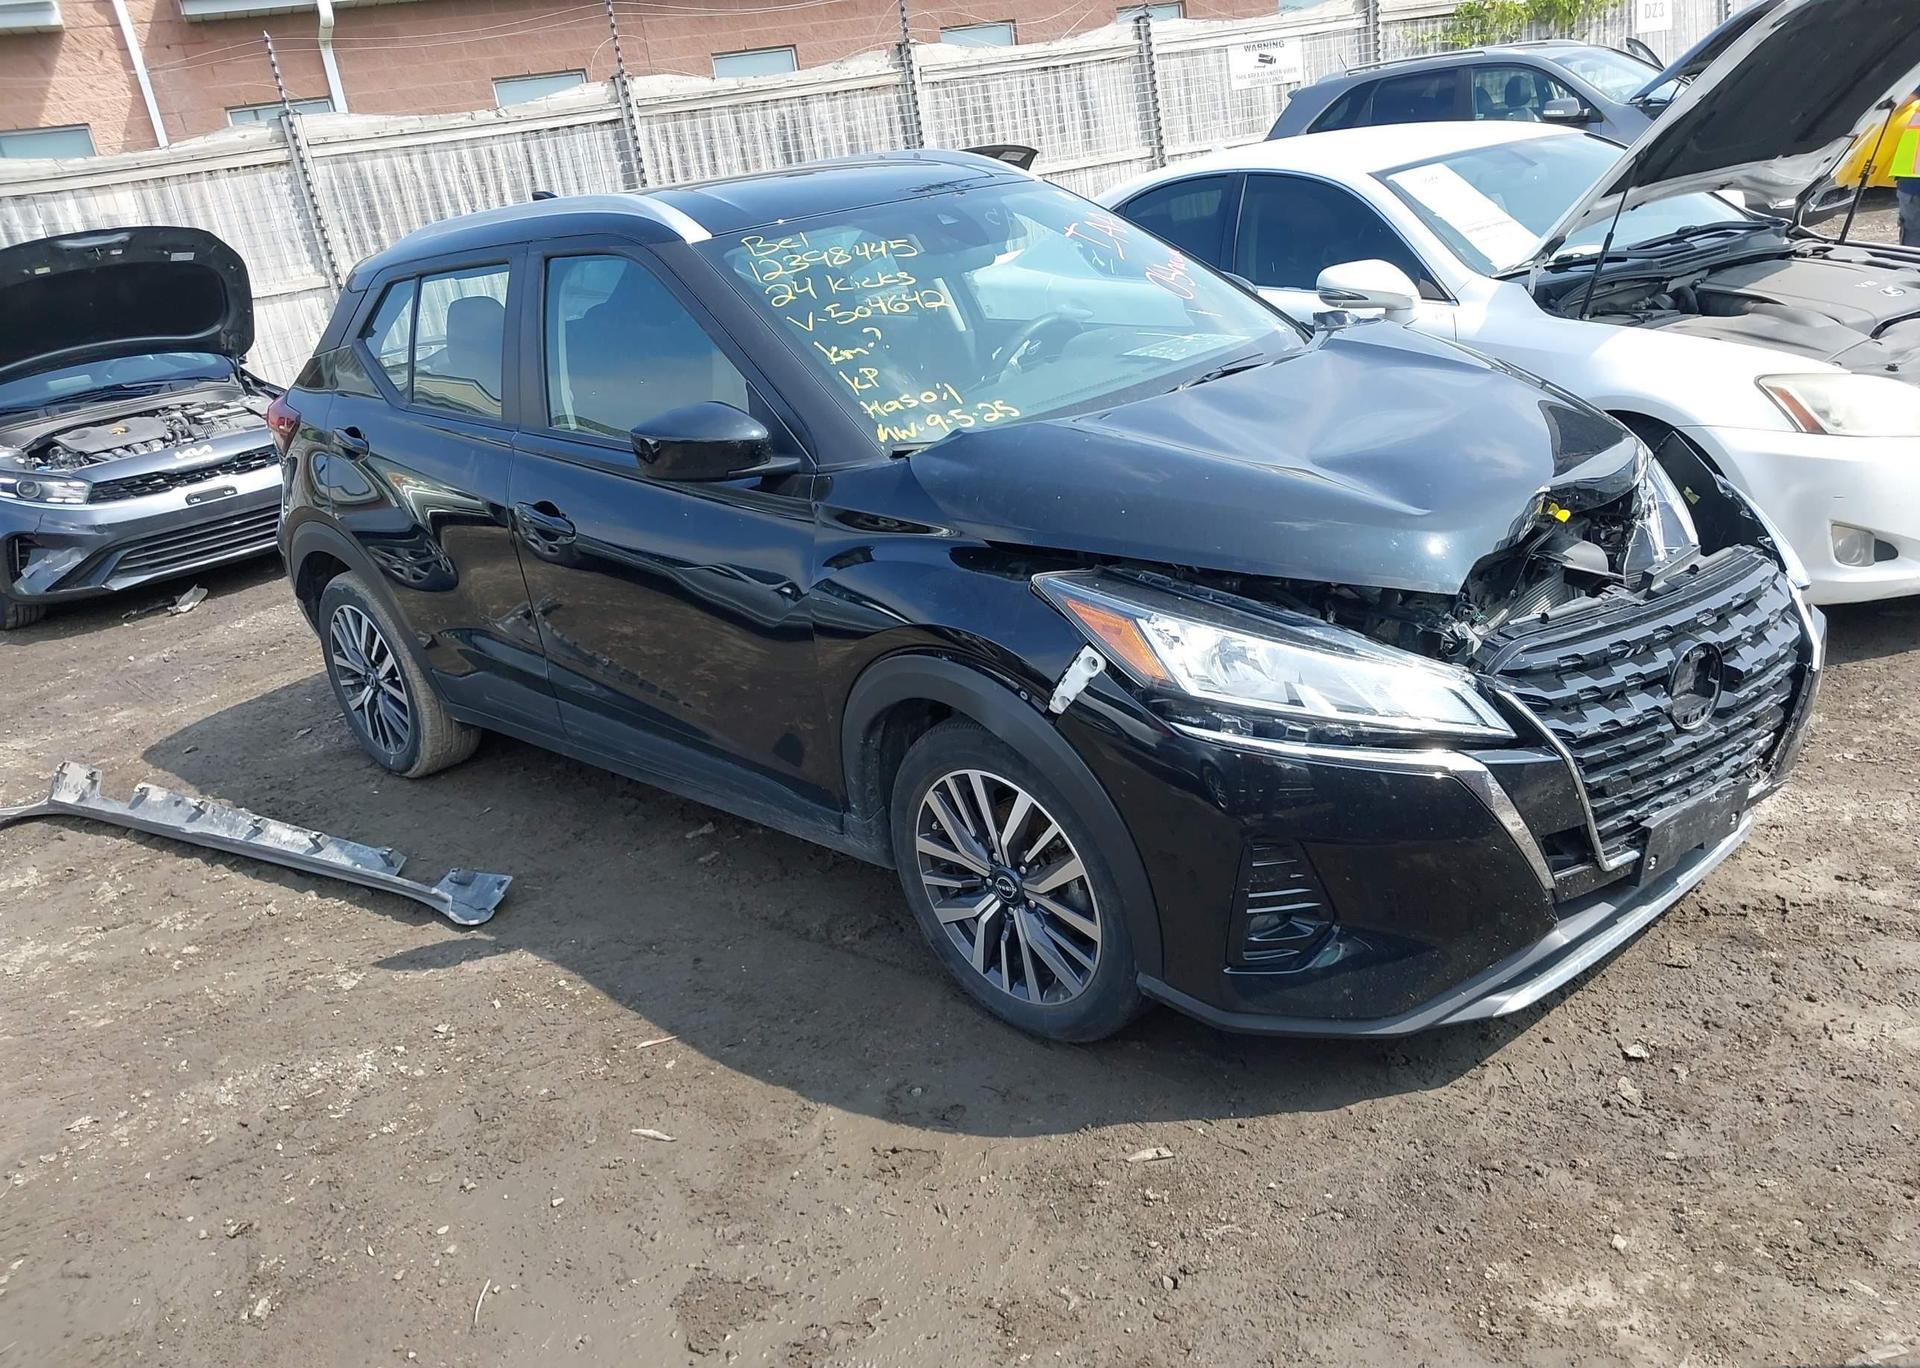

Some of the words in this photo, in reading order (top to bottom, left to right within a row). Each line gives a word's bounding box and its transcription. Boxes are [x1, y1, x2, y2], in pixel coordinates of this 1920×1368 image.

[1243, 40, 1285, 52] WARNING
[749, 239, 918, 283] 12398445
[765, 277, 818, 308] 24
